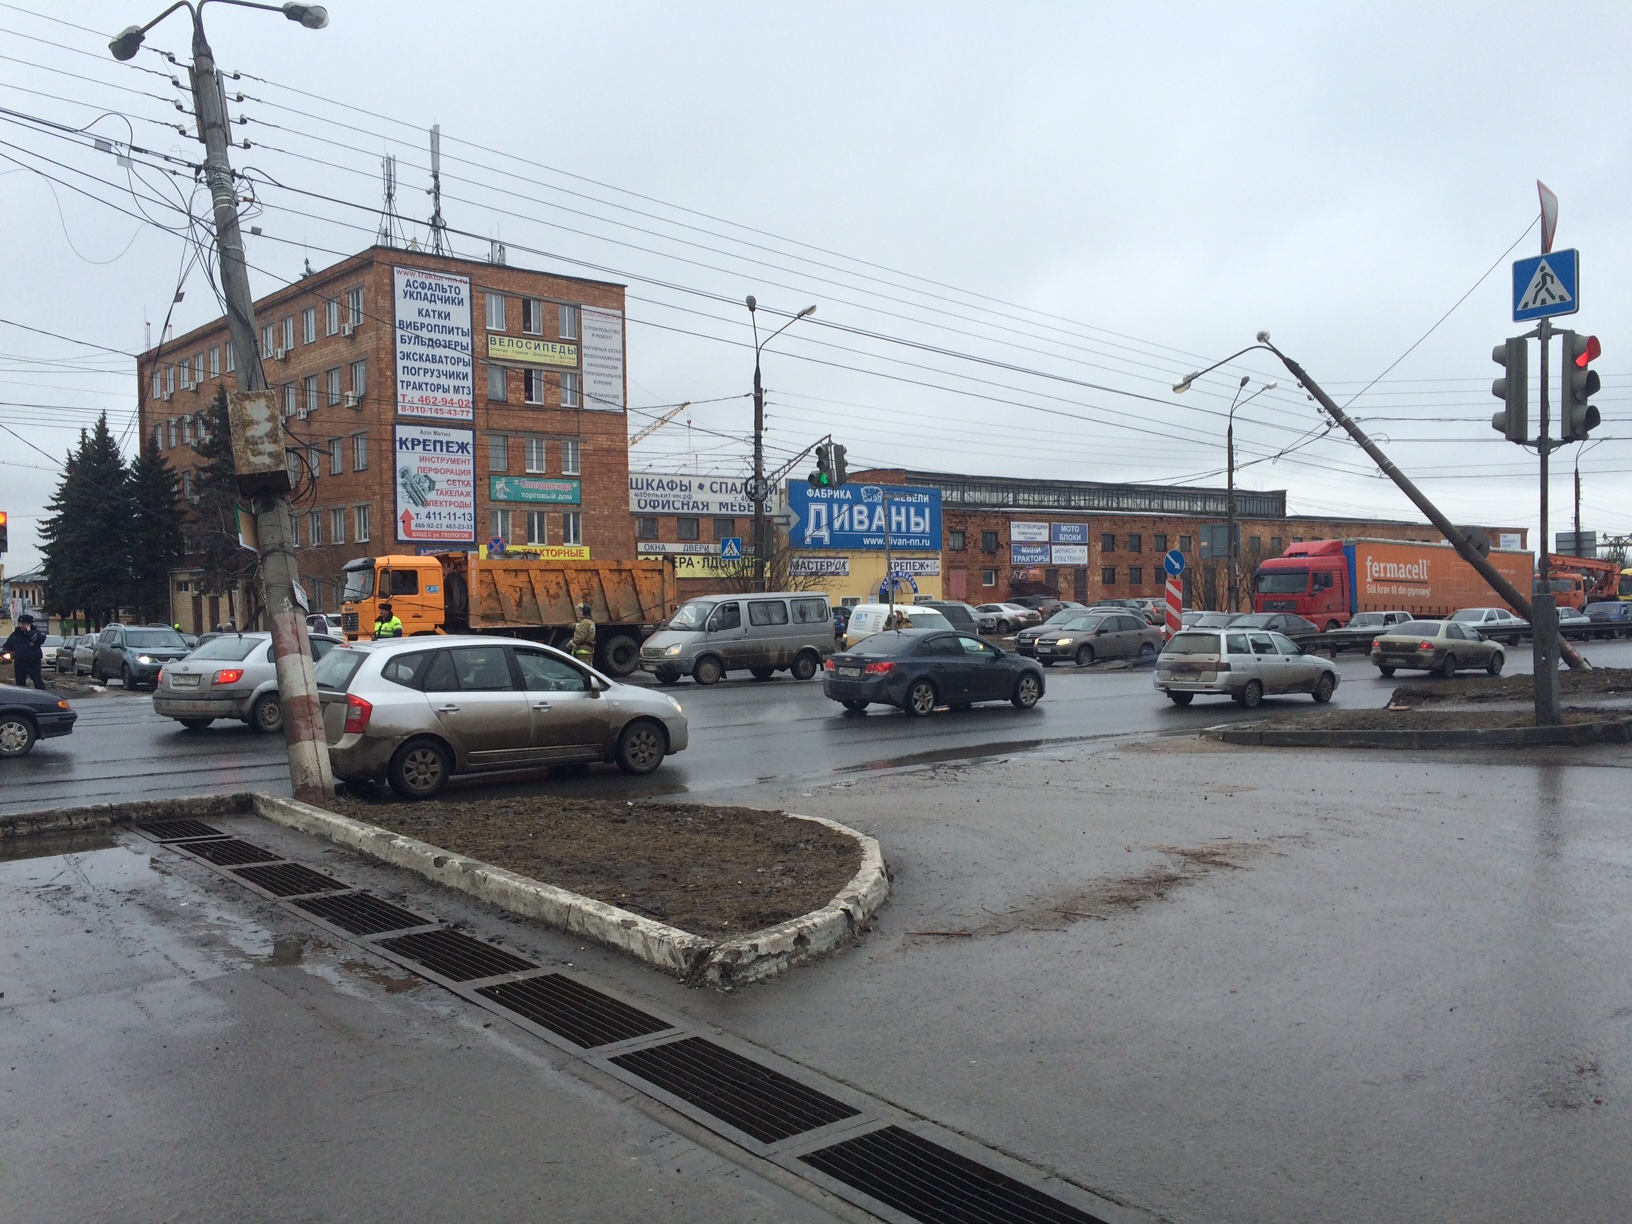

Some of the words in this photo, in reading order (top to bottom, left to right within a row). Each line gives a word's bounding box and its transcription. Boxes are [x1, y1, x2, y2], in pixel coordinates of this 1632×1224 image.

[405, 279, 460, 295] АСФАЛЬТО
[403, 289, 464, 306] УКЛАДЧИКИ
[418, 308, 450, 320] КАТКИ
[398, 320, 470, 337] ВИБРОПЛИТЫ
[584, 326, 620, 334] СТРОИТЕЛЬСТВО
[400, 334, 469, 351] БУЛЬДОЗЕРЫ
[490, 337, 576, 354] ВЕЛОСИПЕДЫ
[400, 351, 470, 367] ЭКСКАВАТОРЫ
[402, 366, 468, 381] ПОГРУЗЧИКИ
[400, 380, 450, 394] ТРАКТОРЫ
[453, 385, 471, 395] МТЗ
[418, 396, 470, 408] 462-94-02
[401, 406, 470, 416] 8-910-145-43-77
[398, 437, 470, 454] КРЕПЕЖ
[419, 456, 471, 465] ИНСТРУМЕНТ
[418, 466, 472, 476] ПЕРФОРАЦИЯ
[446, 479, 472, 487] СЕТКА
[630, 478, 692, 492] ШКАФЫ
[436, 489, 472, 498] ТАКЕЛАЖ
[806, 488, 852, 500] ФАБРИКА
[424, 500, 472, 508] ЭЛЕКТРОДЫ
[638, 499, 709, 511] ОФИСНАЯ
[719, 502, 772, 512] МЕБЕЬ
[426, 512, 472, 521] 411-11-13
[804, 502, 930, 544] ДИВАНЫ
[863, 536, 930, 546] www.ivan-nn.ru
[644, 544, 666, 552] ОКНА
[1366, 584, 1376, 594] Stil
